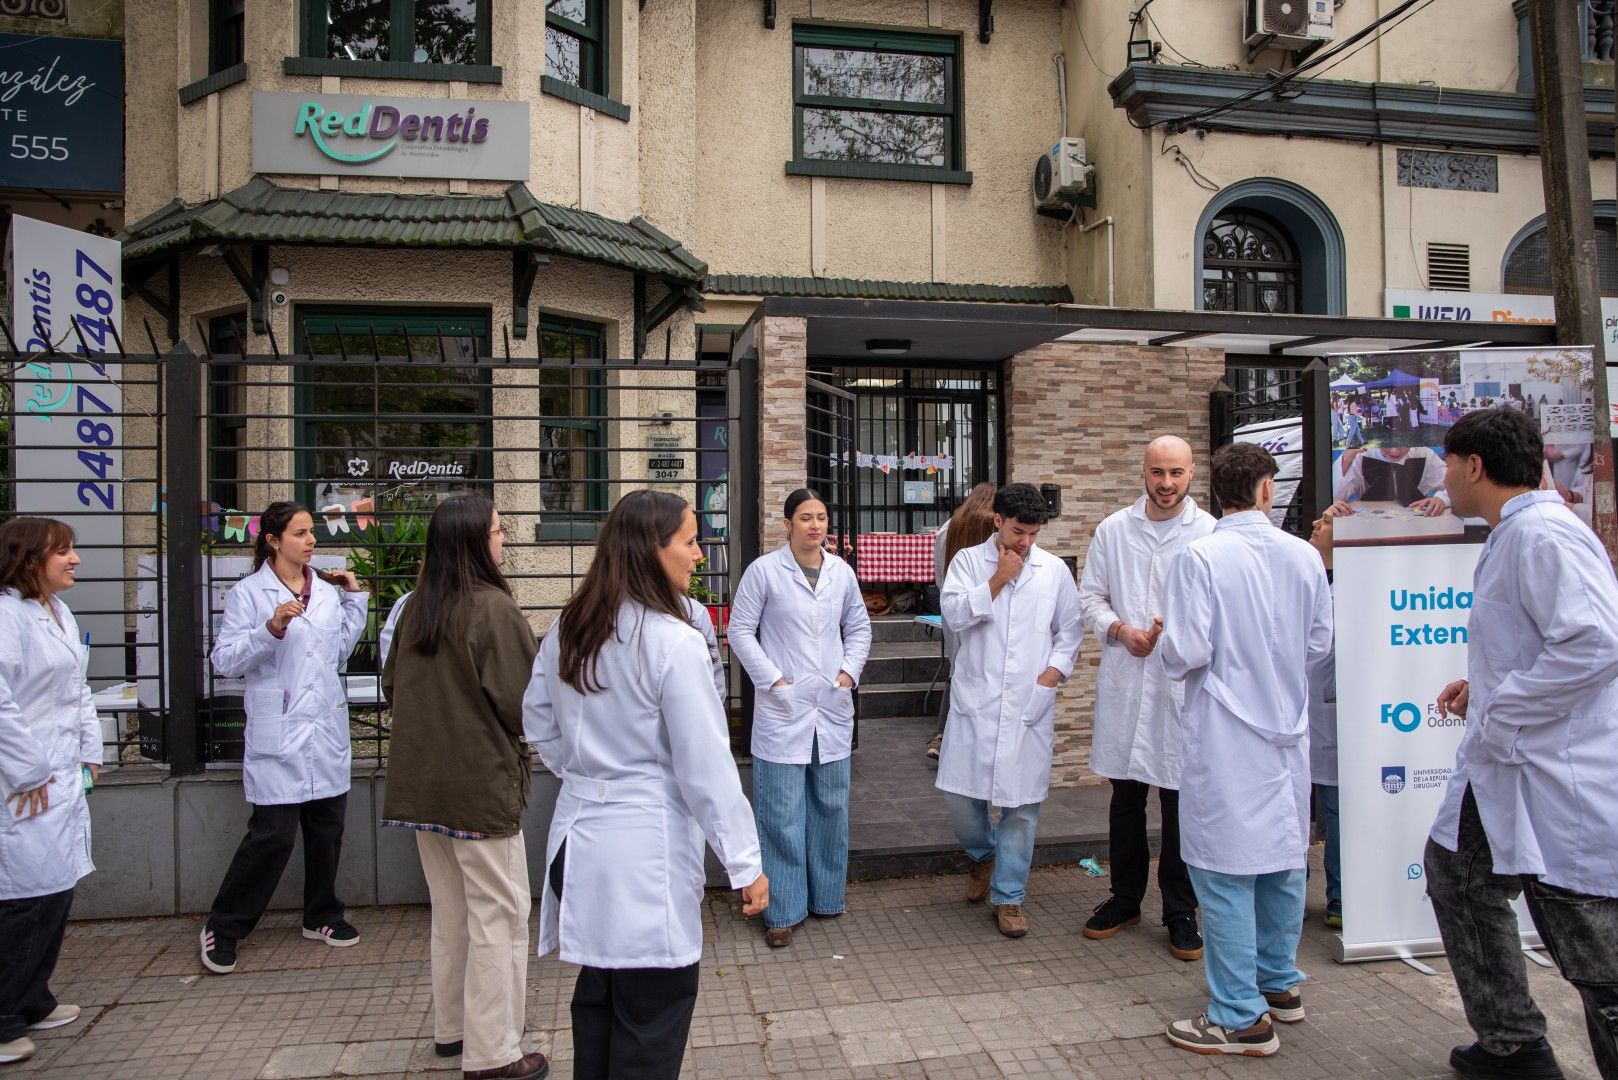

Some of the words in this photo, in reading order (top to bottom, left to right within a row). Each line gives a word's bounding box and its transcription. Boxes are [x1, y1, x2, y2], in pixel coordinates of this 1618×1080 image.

[294, 101, 490, 160] RedDentis
[10, 134, 69, 160] 555
[76, 385, 114, 510] 2487
[388, 461, 463, 481] RedDentis
[655, 471, 679, 479] 3047
[1390, 586, 1473, 611] Unida
[1390, 623, 1468, 646] Exten
[1413, 767, 1452, 776] UNIVERSIDAD
